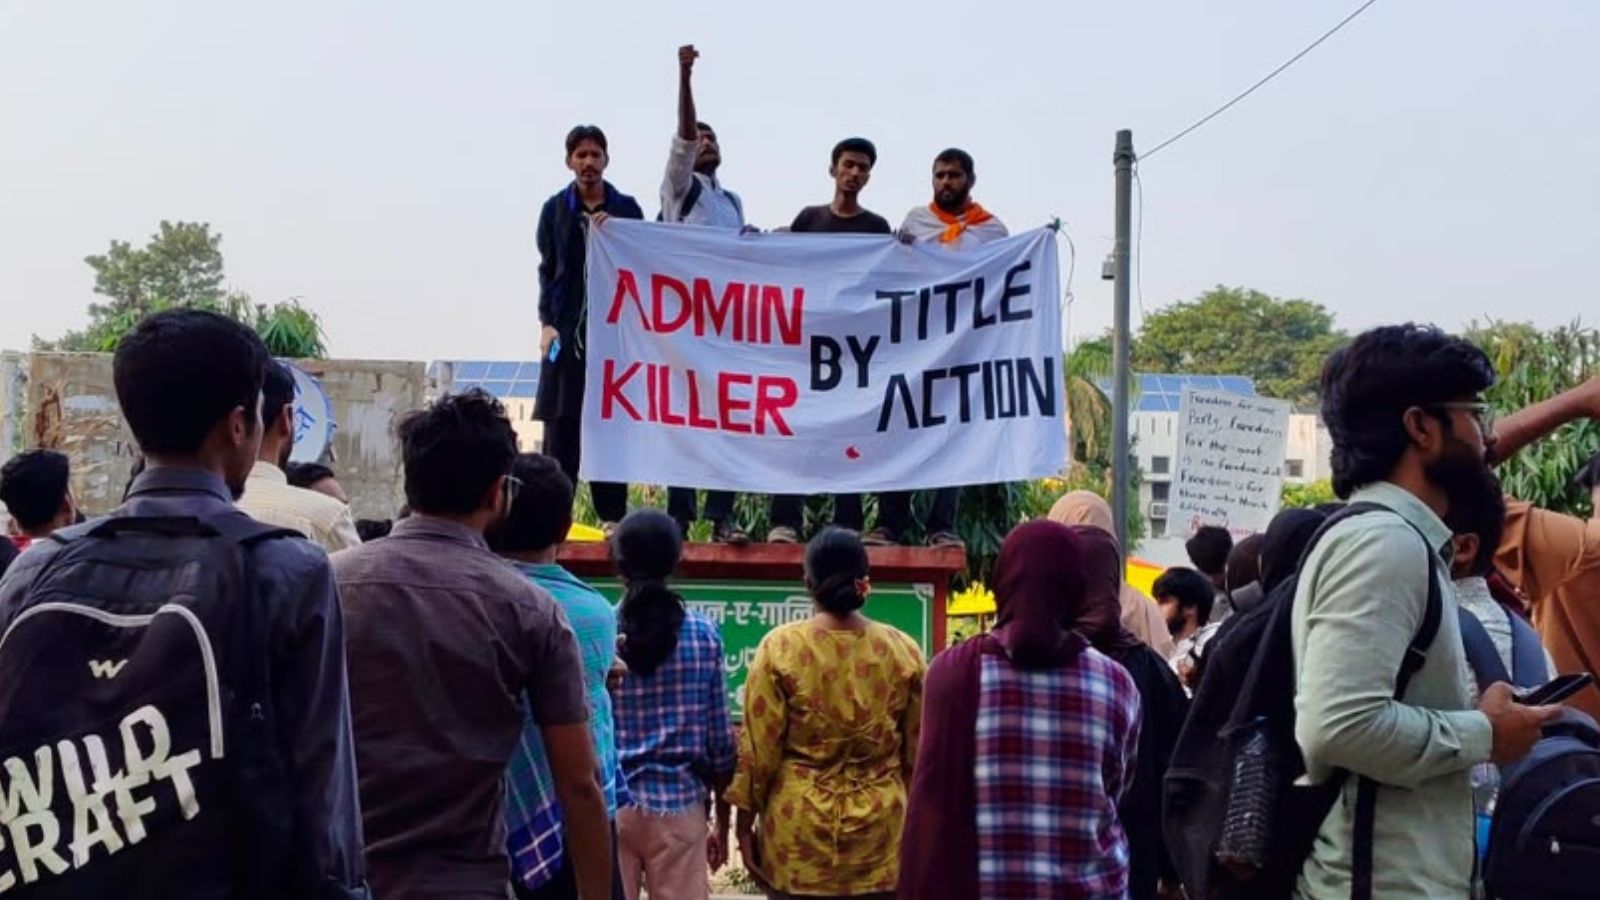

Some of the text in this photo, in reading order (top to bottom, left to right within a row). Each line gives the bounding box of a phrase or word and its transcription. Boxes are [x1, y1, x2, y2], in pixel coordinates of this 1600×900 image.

[606, 260, 1032, 391] ADMIN BY TITLE
[601, 356, 1056, 437] KILLER ACTION
[0, 704, 171, 826] WILD
